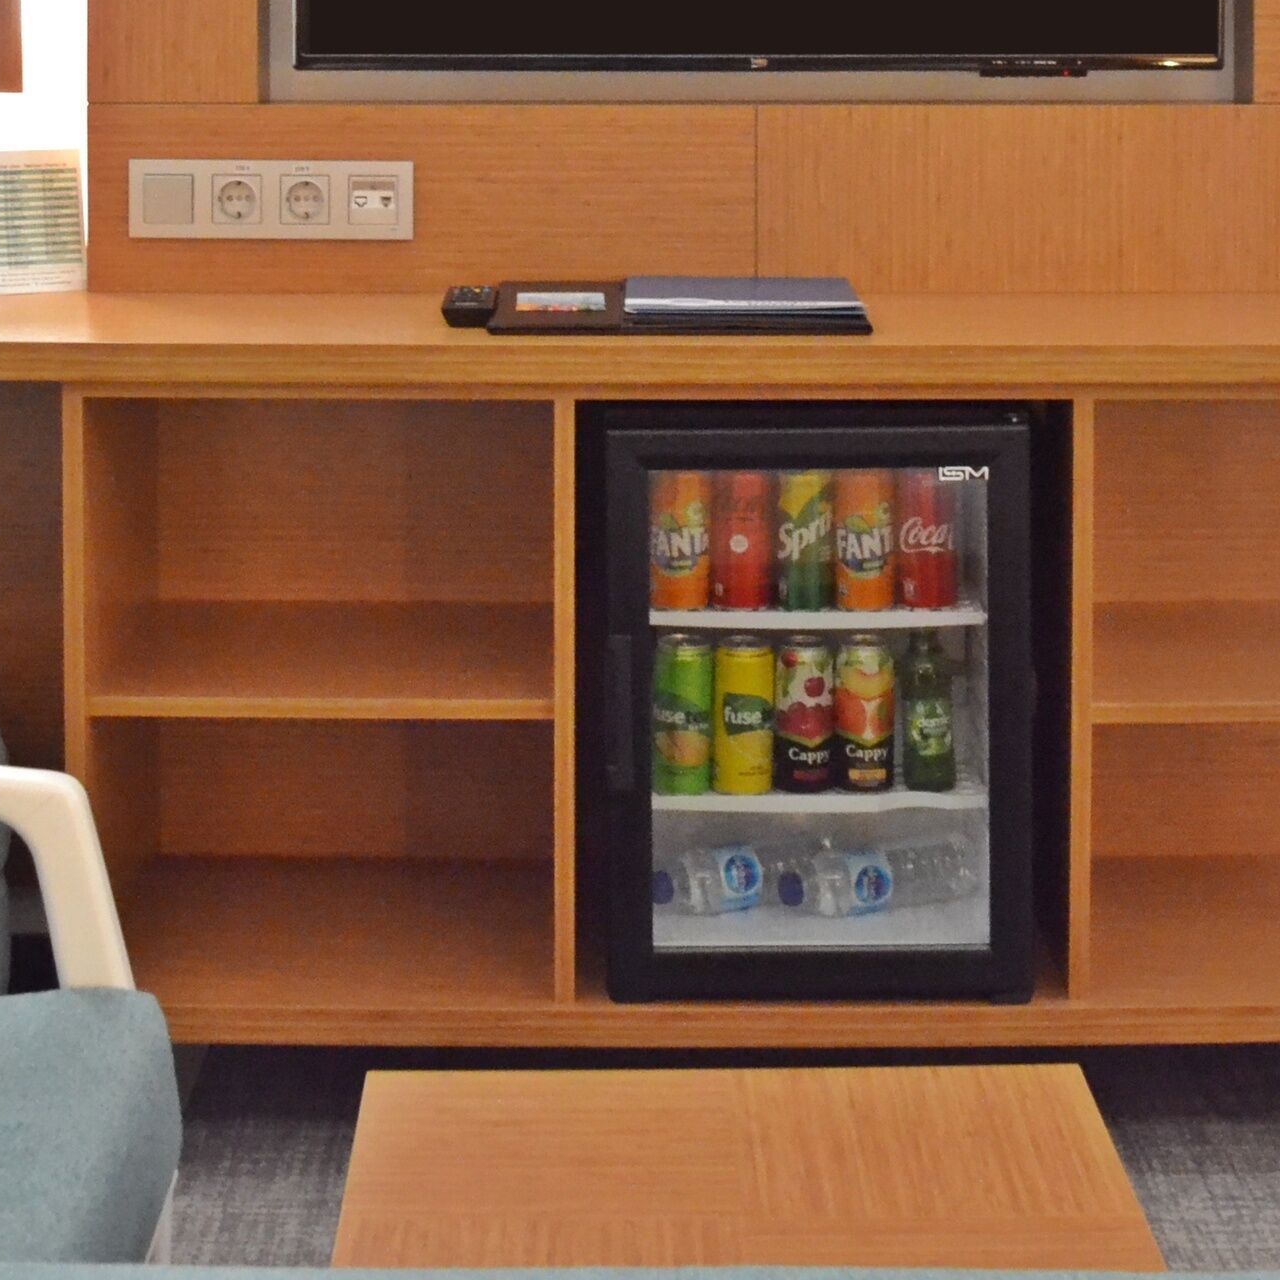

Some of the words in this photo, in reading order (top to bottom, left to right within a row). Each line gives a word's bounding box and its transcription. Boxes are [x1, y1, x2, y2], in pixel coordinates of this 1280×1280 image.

[836, 525, 894, 559] FANT
[723, 705, 763, 726] fuse
[788, 747, 830, 765] Cappy
[846, 744, 889, 762] Cappy
